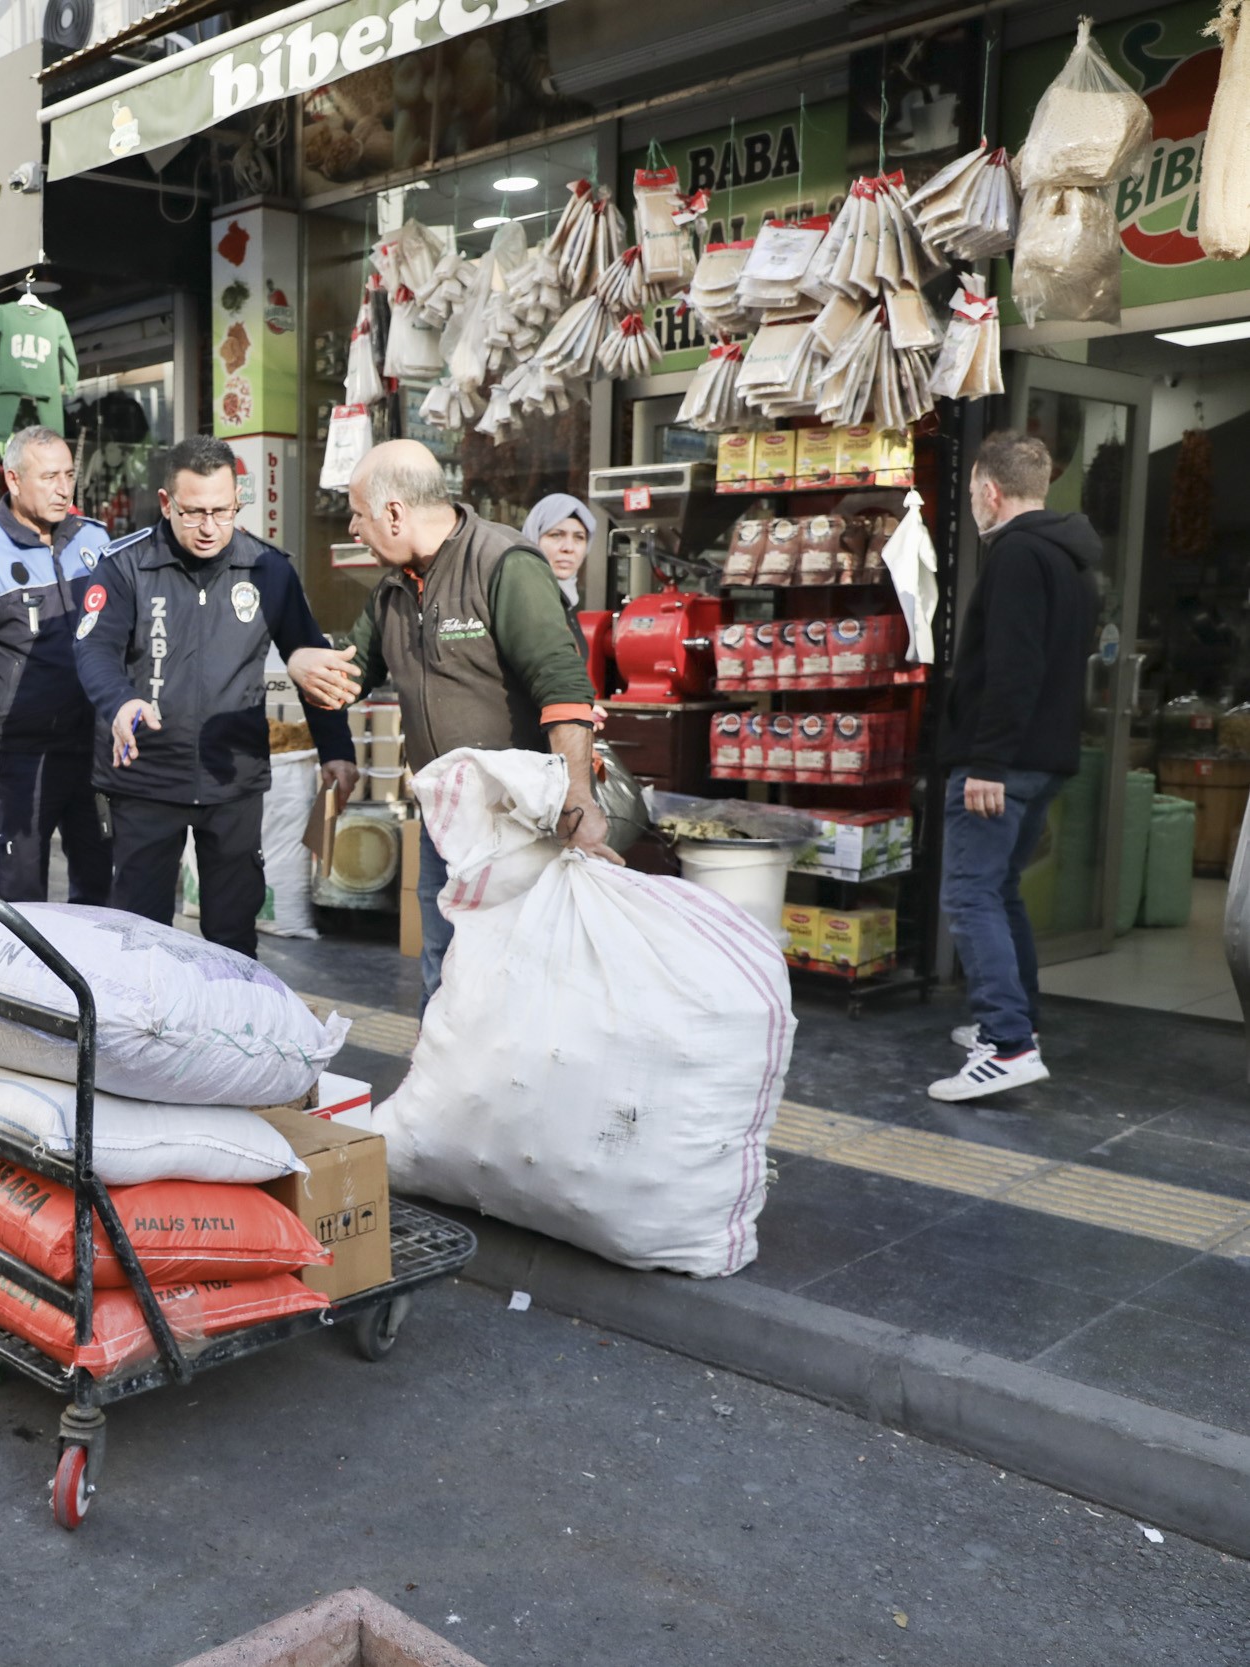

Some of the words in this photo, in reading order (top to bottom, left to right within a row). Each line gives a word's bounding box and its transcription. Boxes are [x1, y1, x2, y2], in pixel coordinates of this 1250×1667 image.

[209, 0, 548, 119] biberc
[688, 126, 800, 196] BABA
[11, 333, 51, 363] GAP
[267, 451, 278, 538] biber
[134, 1215, 185, 1231] HALİS
[191, 1217, 235, 1231] TATLI
